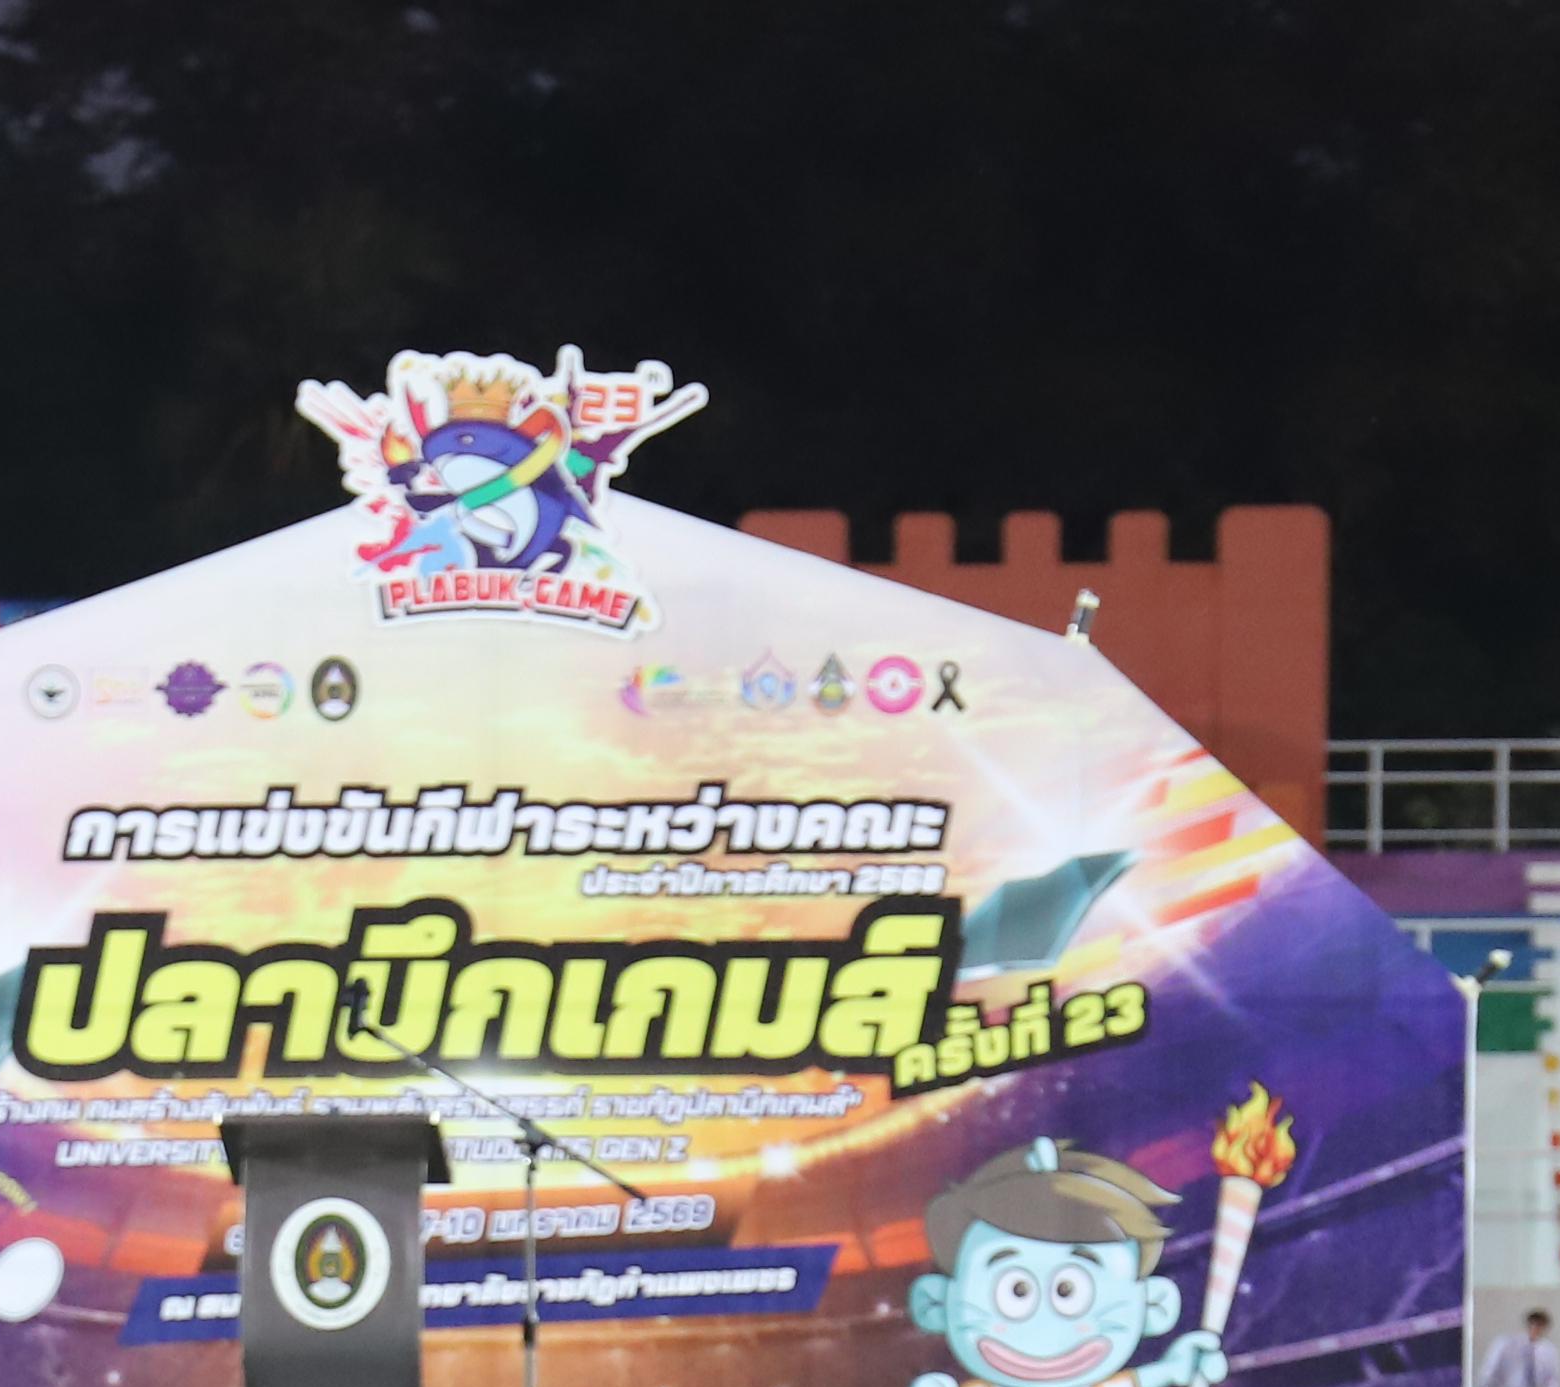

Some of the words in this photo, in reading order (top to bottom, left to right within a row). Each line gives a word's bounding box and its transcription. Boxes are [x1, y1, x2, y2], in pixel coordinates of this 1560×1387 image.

[575, 383, 643, 424] 23
[388, 571, 522, 613] PLABUK
[532, 576, 638, 623] GAME
[64, 782, 946, 861] การแข่งขันกีฬาระหว่างคณะ
[20, 903, 952, 1070] ปลาบึกเกมส์
[893, 982, 1053, 1089] ครั้งที่
[1063, 982, 1148, 1048] 23
[598, 1135, 662, 1162] GEN
[487, 1203, 621, 1242] มกราคม
[622, 1193, 716, 1235] 2569
